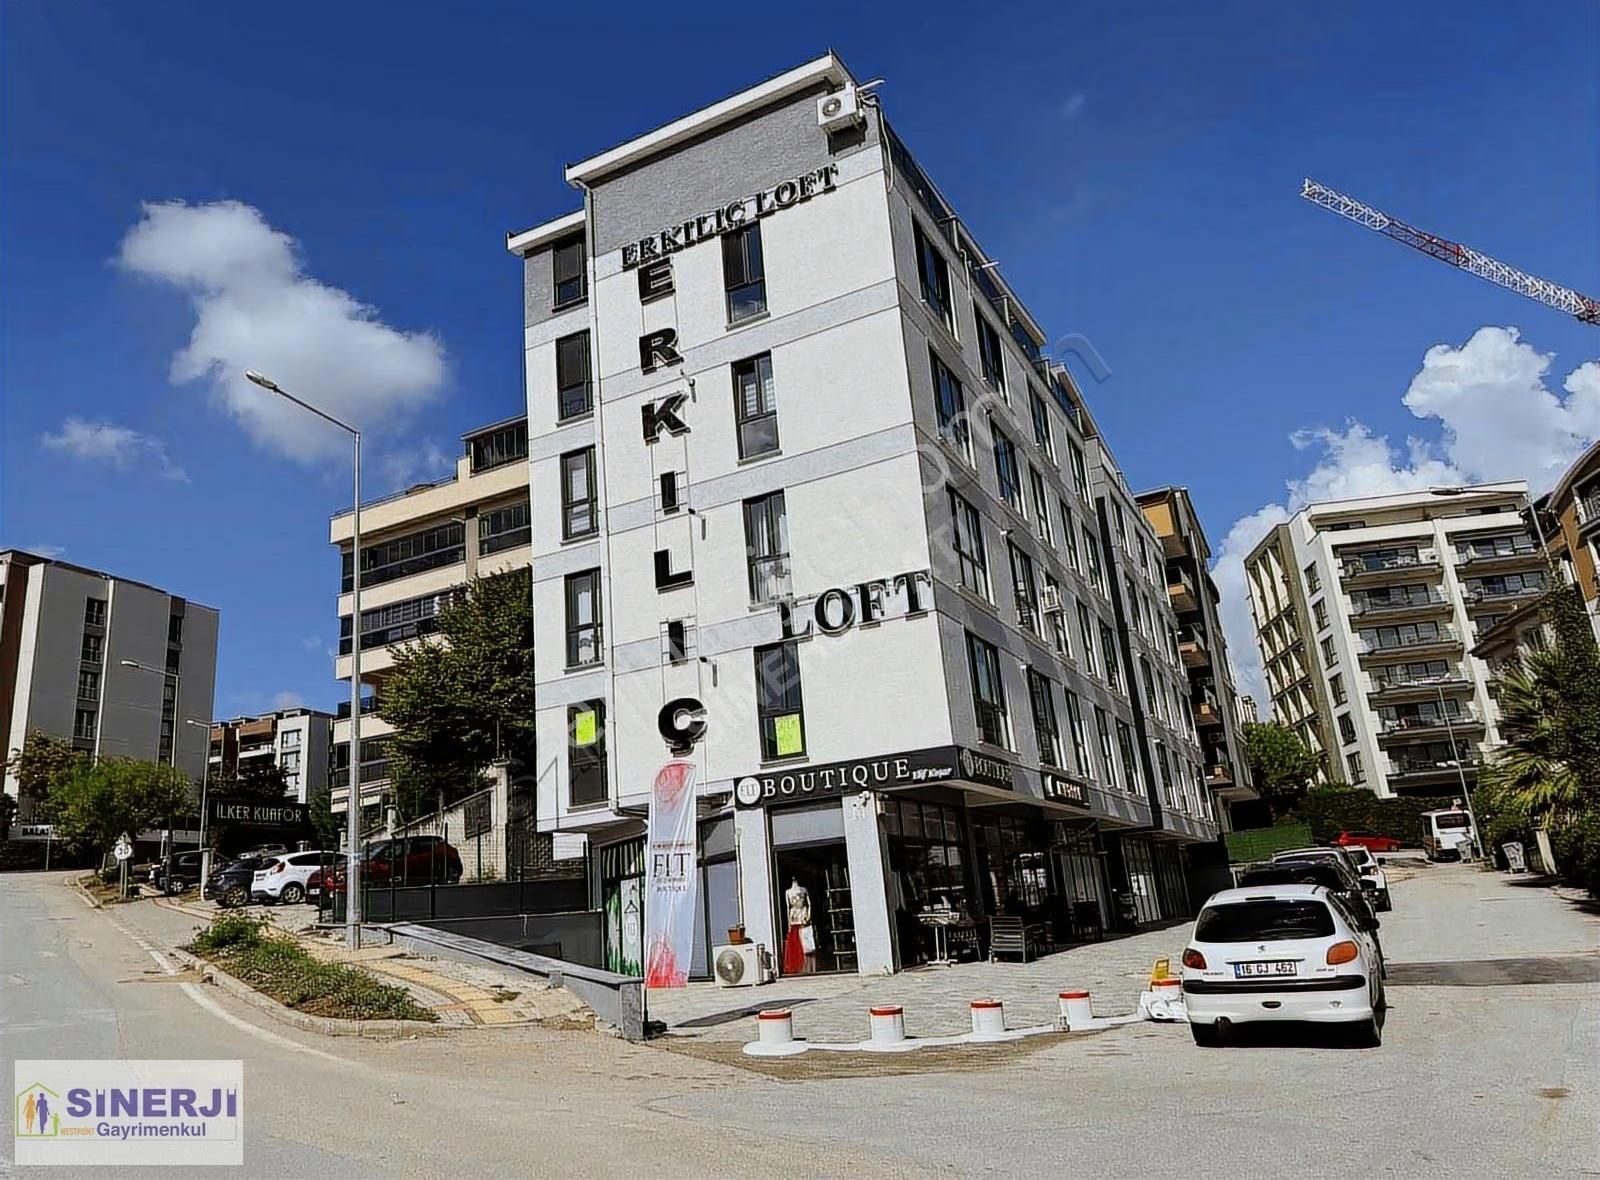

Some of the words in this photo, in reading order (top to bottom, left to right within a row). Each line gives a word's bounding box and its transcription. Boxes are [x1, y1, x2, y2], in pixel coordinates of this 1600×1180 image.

[755, 163, 839, 218] LOFT
[777, 569, 932, 640] LOFT
[762, 759, 910, 797] BOUTIQUE
